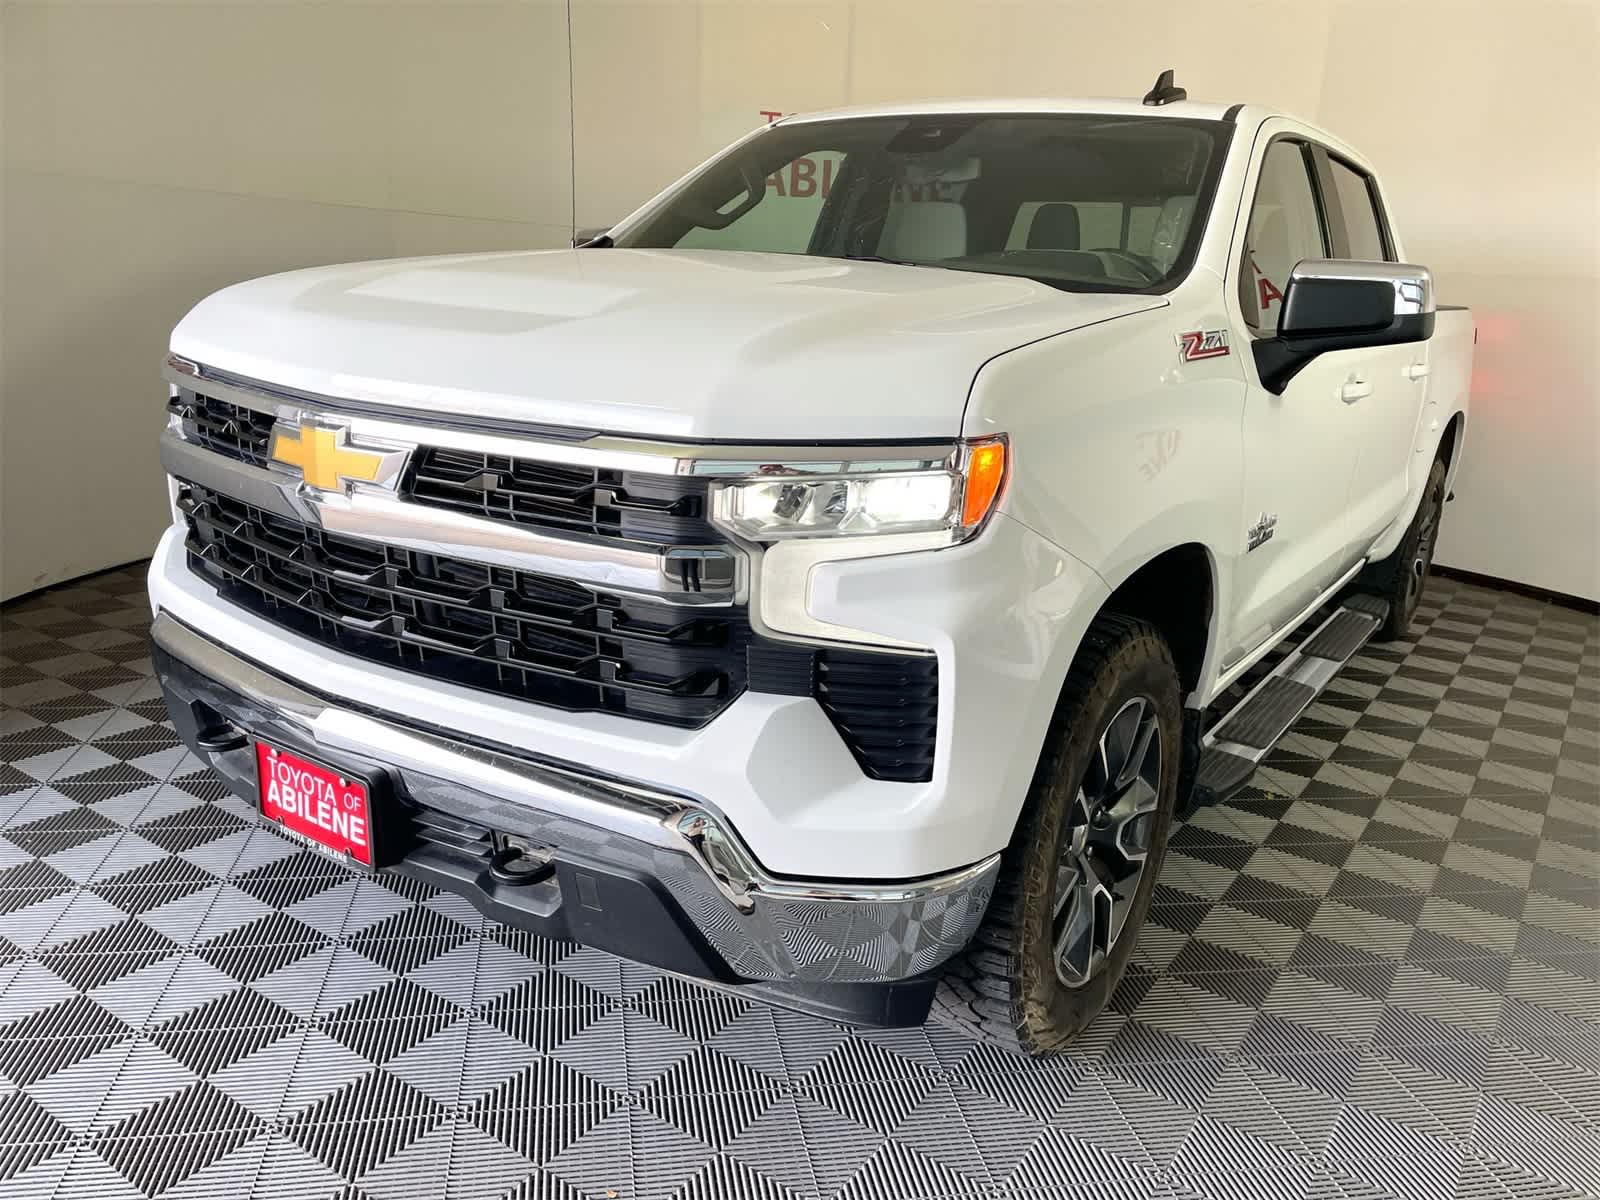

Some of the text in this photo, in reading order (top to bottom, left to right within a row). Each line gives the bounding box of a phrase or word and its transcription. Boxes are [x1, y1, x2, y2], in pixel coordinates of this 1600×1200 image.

[1175, 329, 1230, 363] Z71
[266, 756, 361, 811] TOYOTA OF
[267, 780, 366, 846] ABILENE
[279, 824, 348, 864] TOYOTA OF ABILENE
